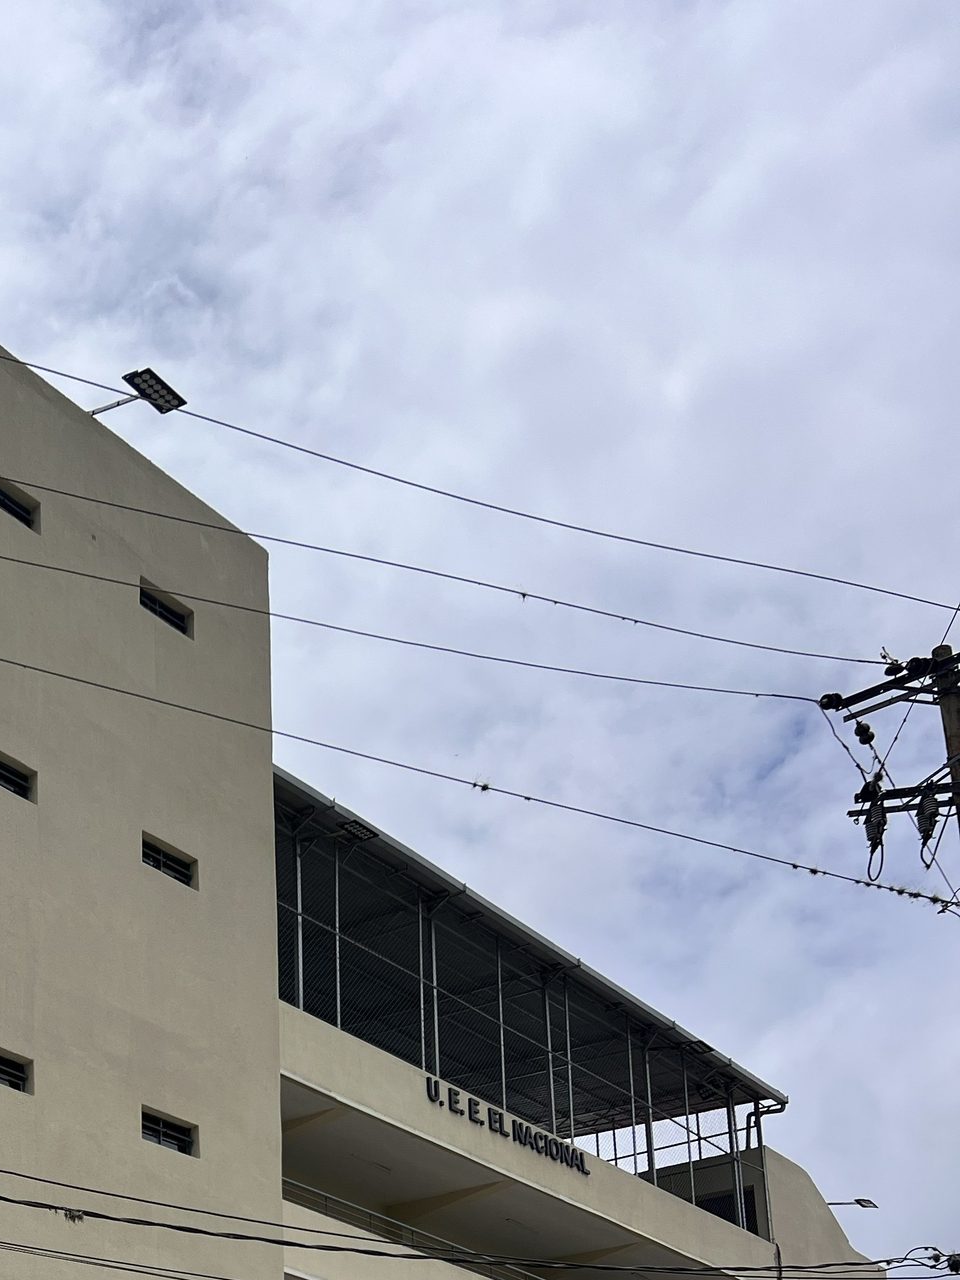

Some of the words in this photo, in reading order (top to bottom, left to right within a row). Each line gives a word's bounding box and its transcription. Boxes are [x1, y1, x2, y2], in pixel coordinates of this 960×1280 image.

[426, 1077, 445, 1107] U.
[448, 1087, 465, 1116] E.
[468, 1097, 485, 1126] E.
[487, 1107, 510, 1137] EL
[512, 1119, 591, 1176] NACIONAL
